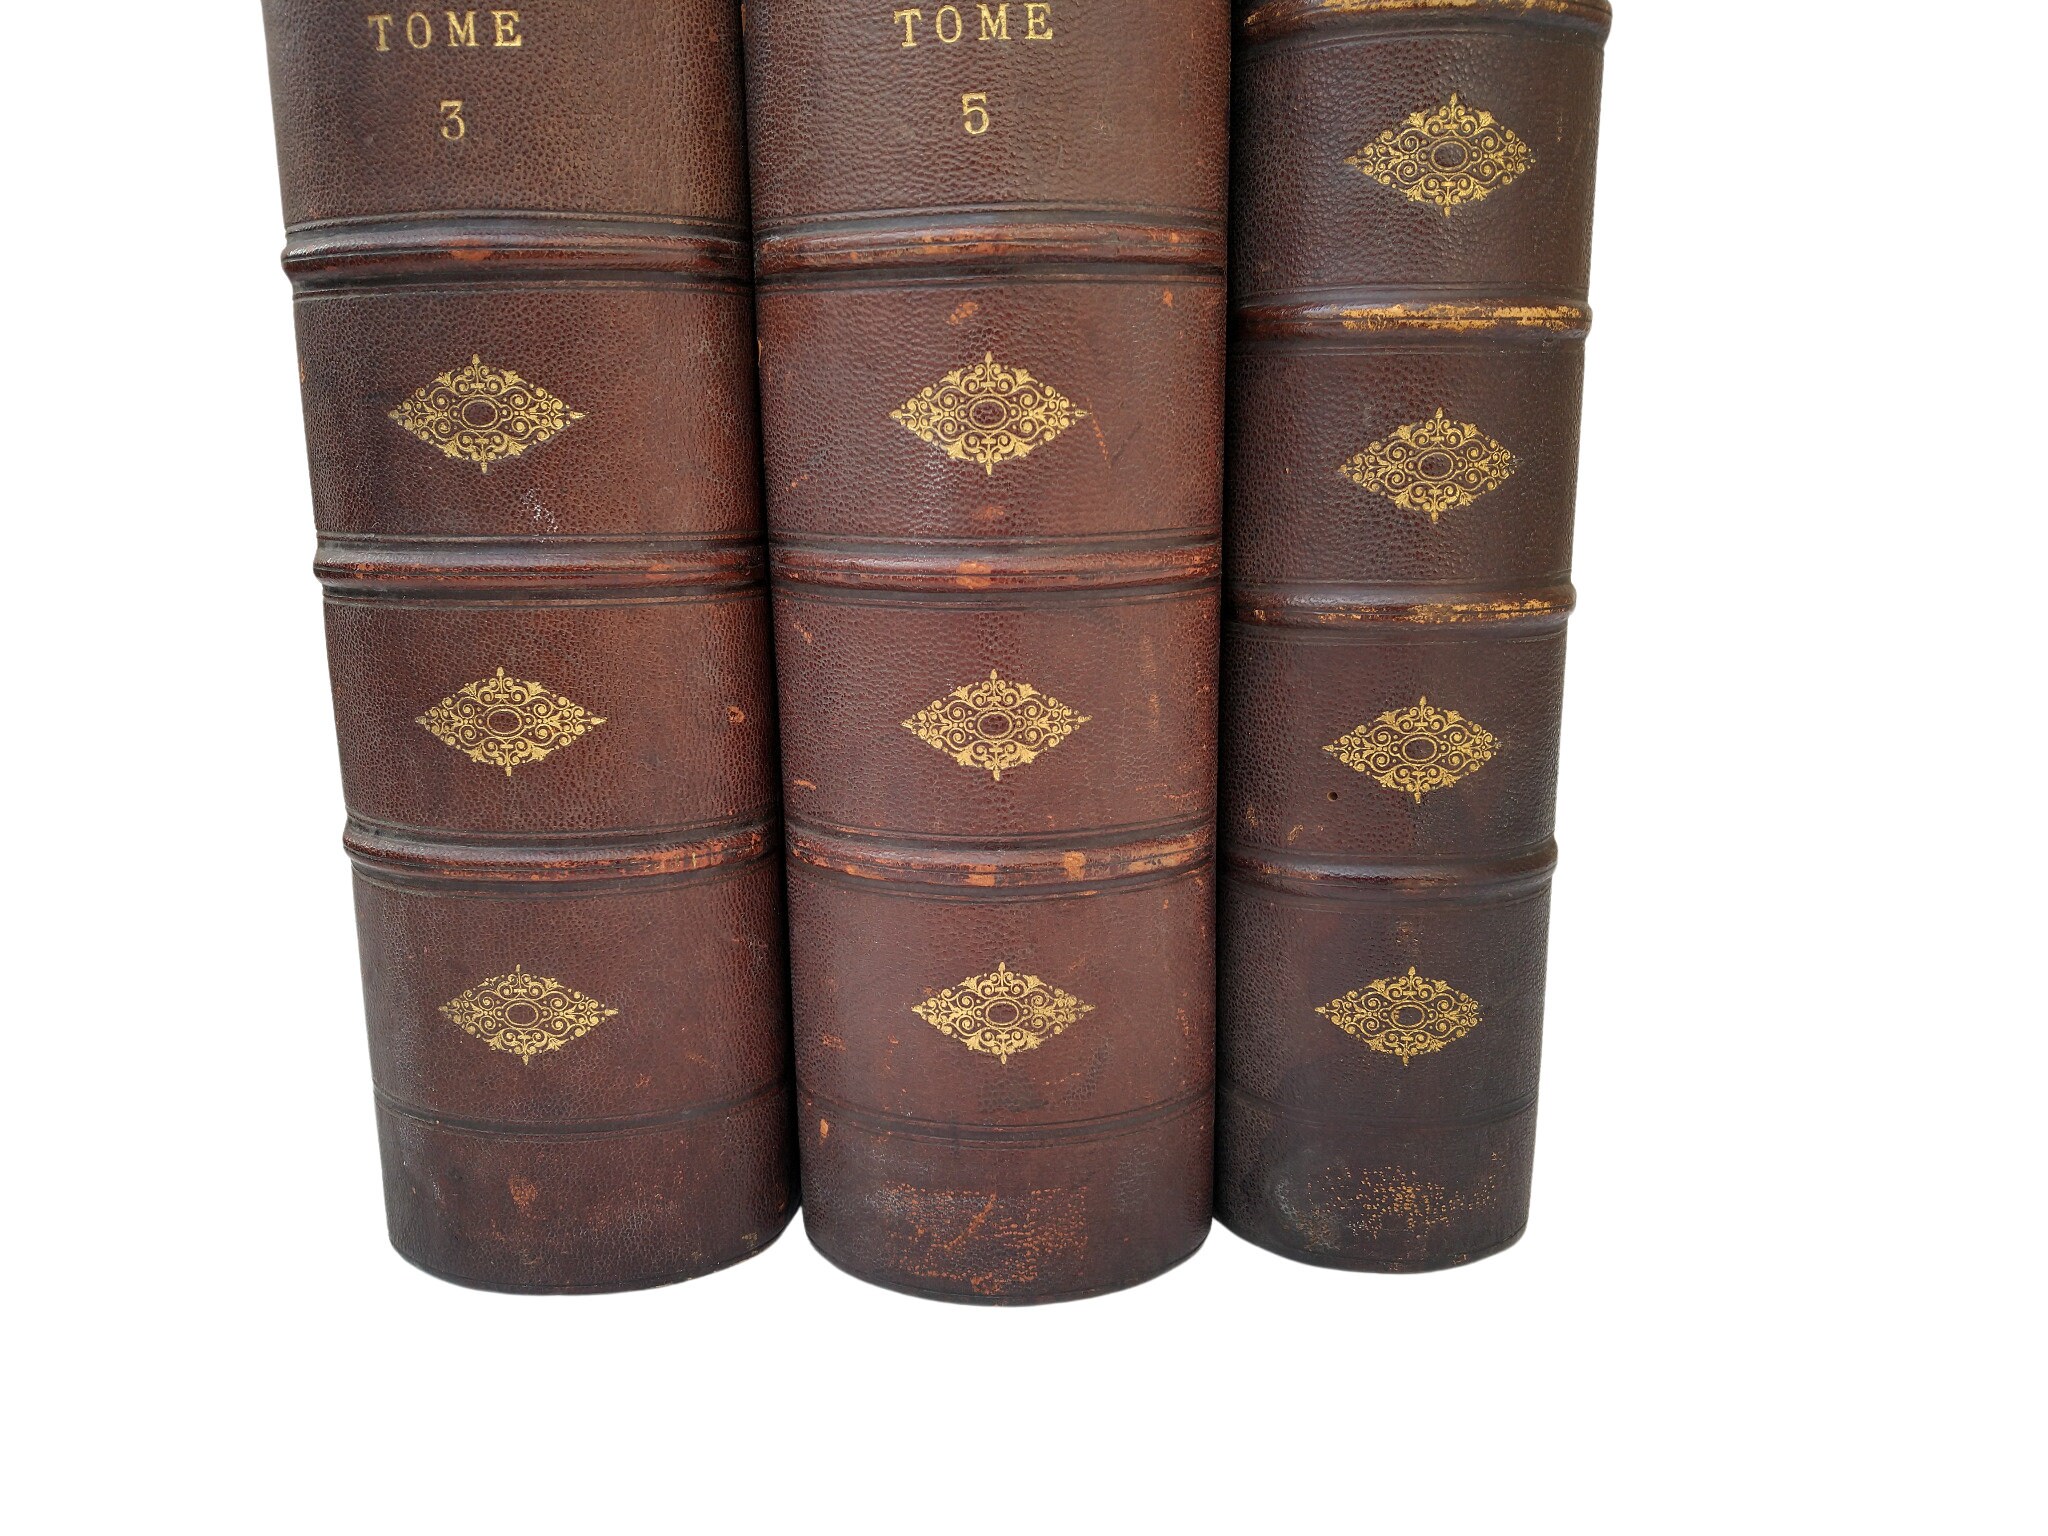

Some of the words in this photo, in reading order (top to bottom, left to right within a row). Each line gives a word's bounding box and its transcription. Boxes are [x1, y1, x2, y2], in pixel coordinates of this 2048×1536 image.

[367, 10, 522, 51] TOME
[893, 2, 1053, 47] TOME
[440, 100, 465, 140] 3
[961, 92, 989, 134] 5
